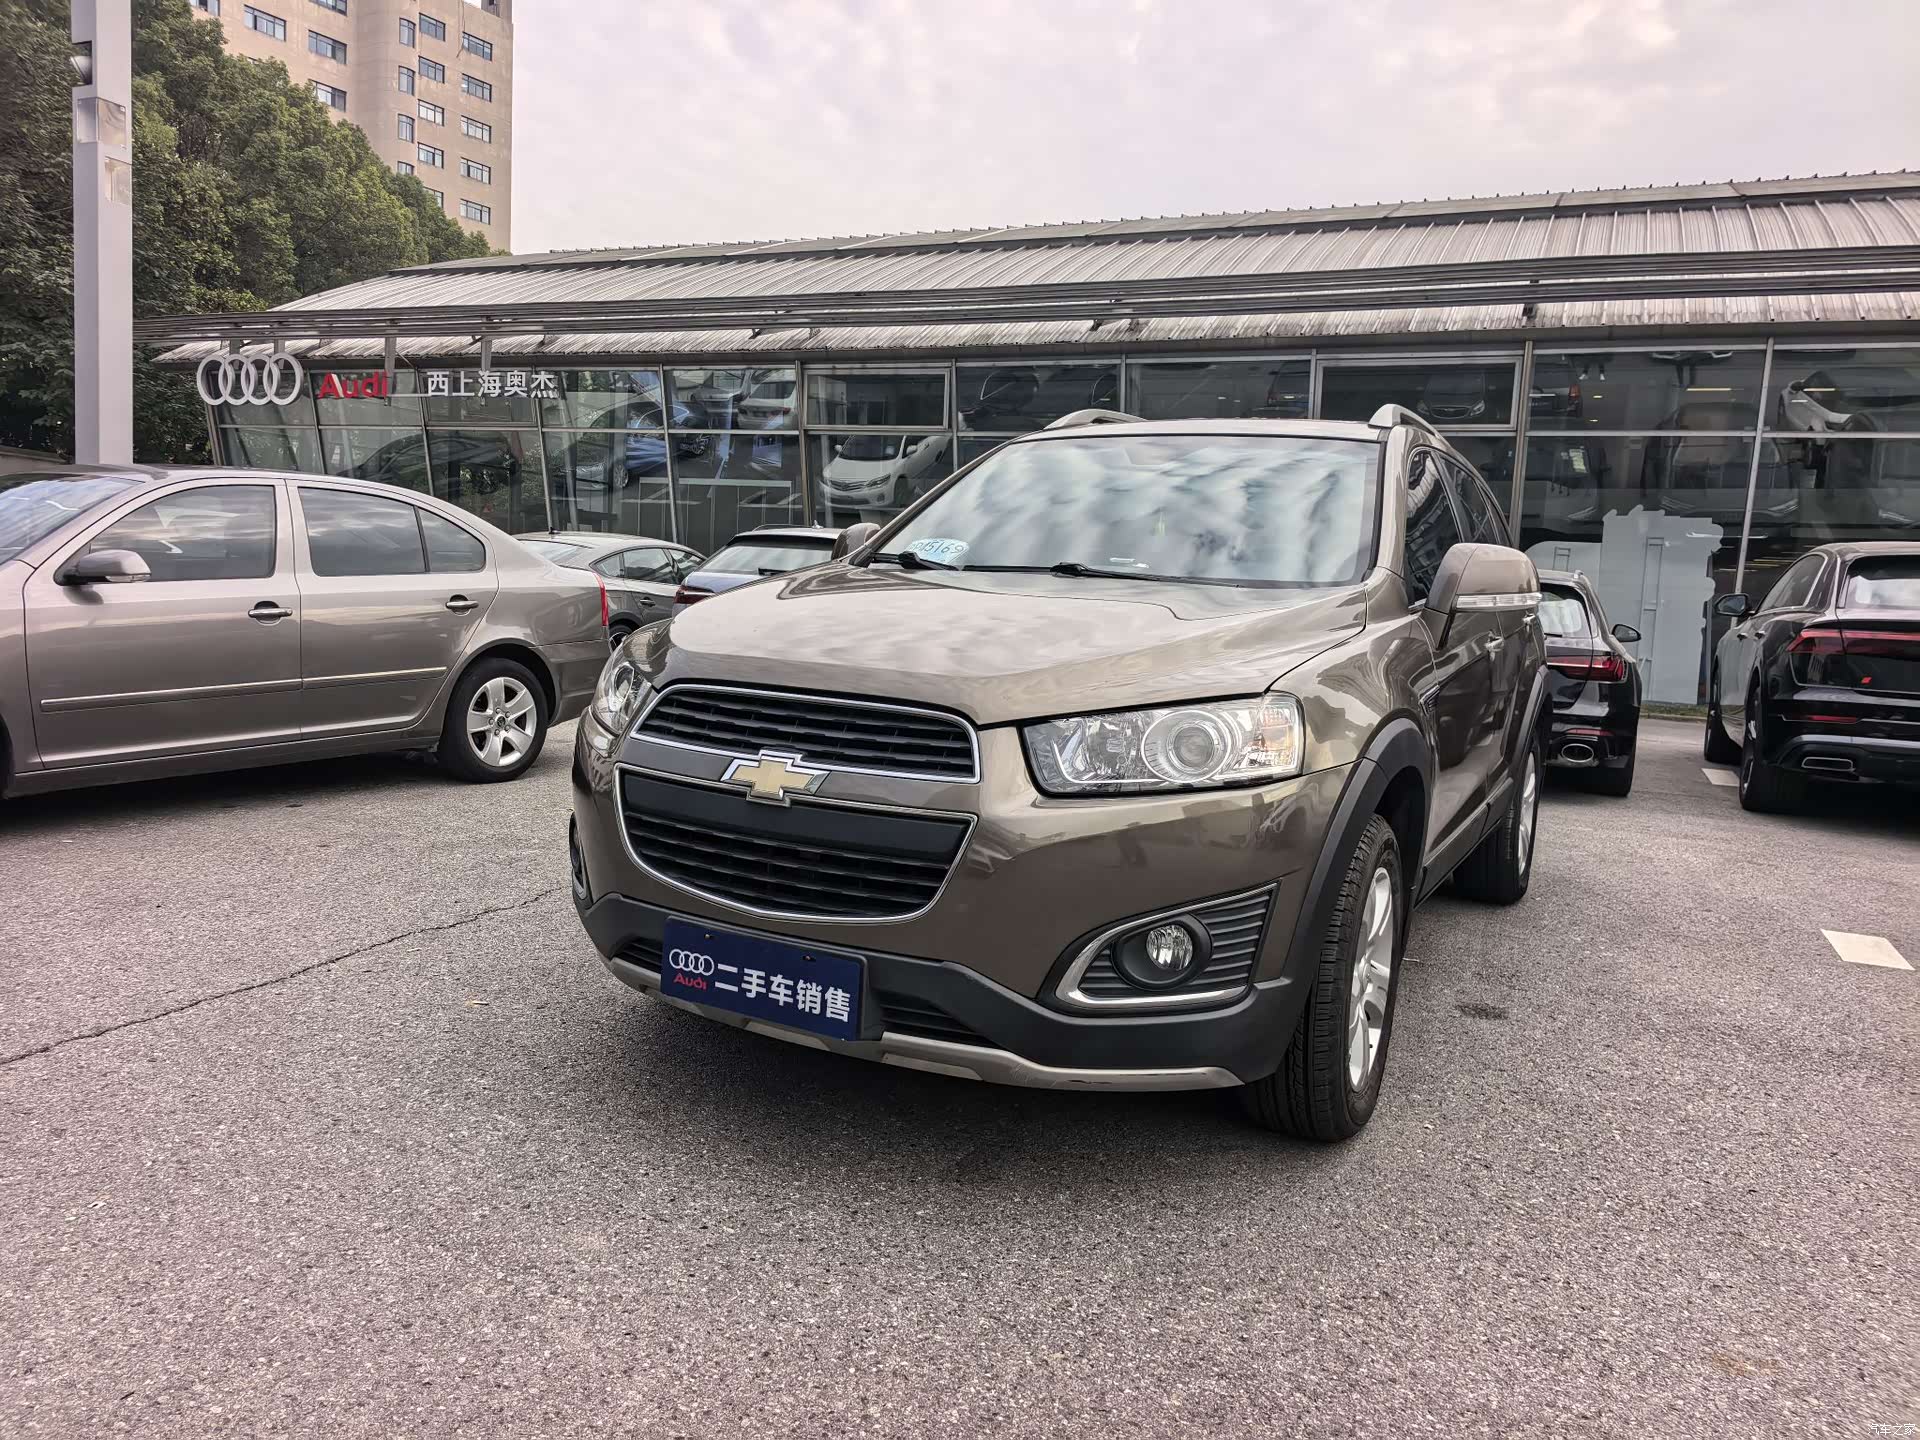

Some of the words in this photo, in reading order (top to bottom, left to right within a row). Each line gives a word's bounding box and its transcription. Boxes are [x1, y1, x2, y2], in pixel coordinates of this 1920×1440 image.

[319, 370, 388, 398] Audi
[427, 370, 557, 399] 西上海奥杰
[673, 973, 707, 991] Audi
[715, 963, 851, 1023] 二手车销售
